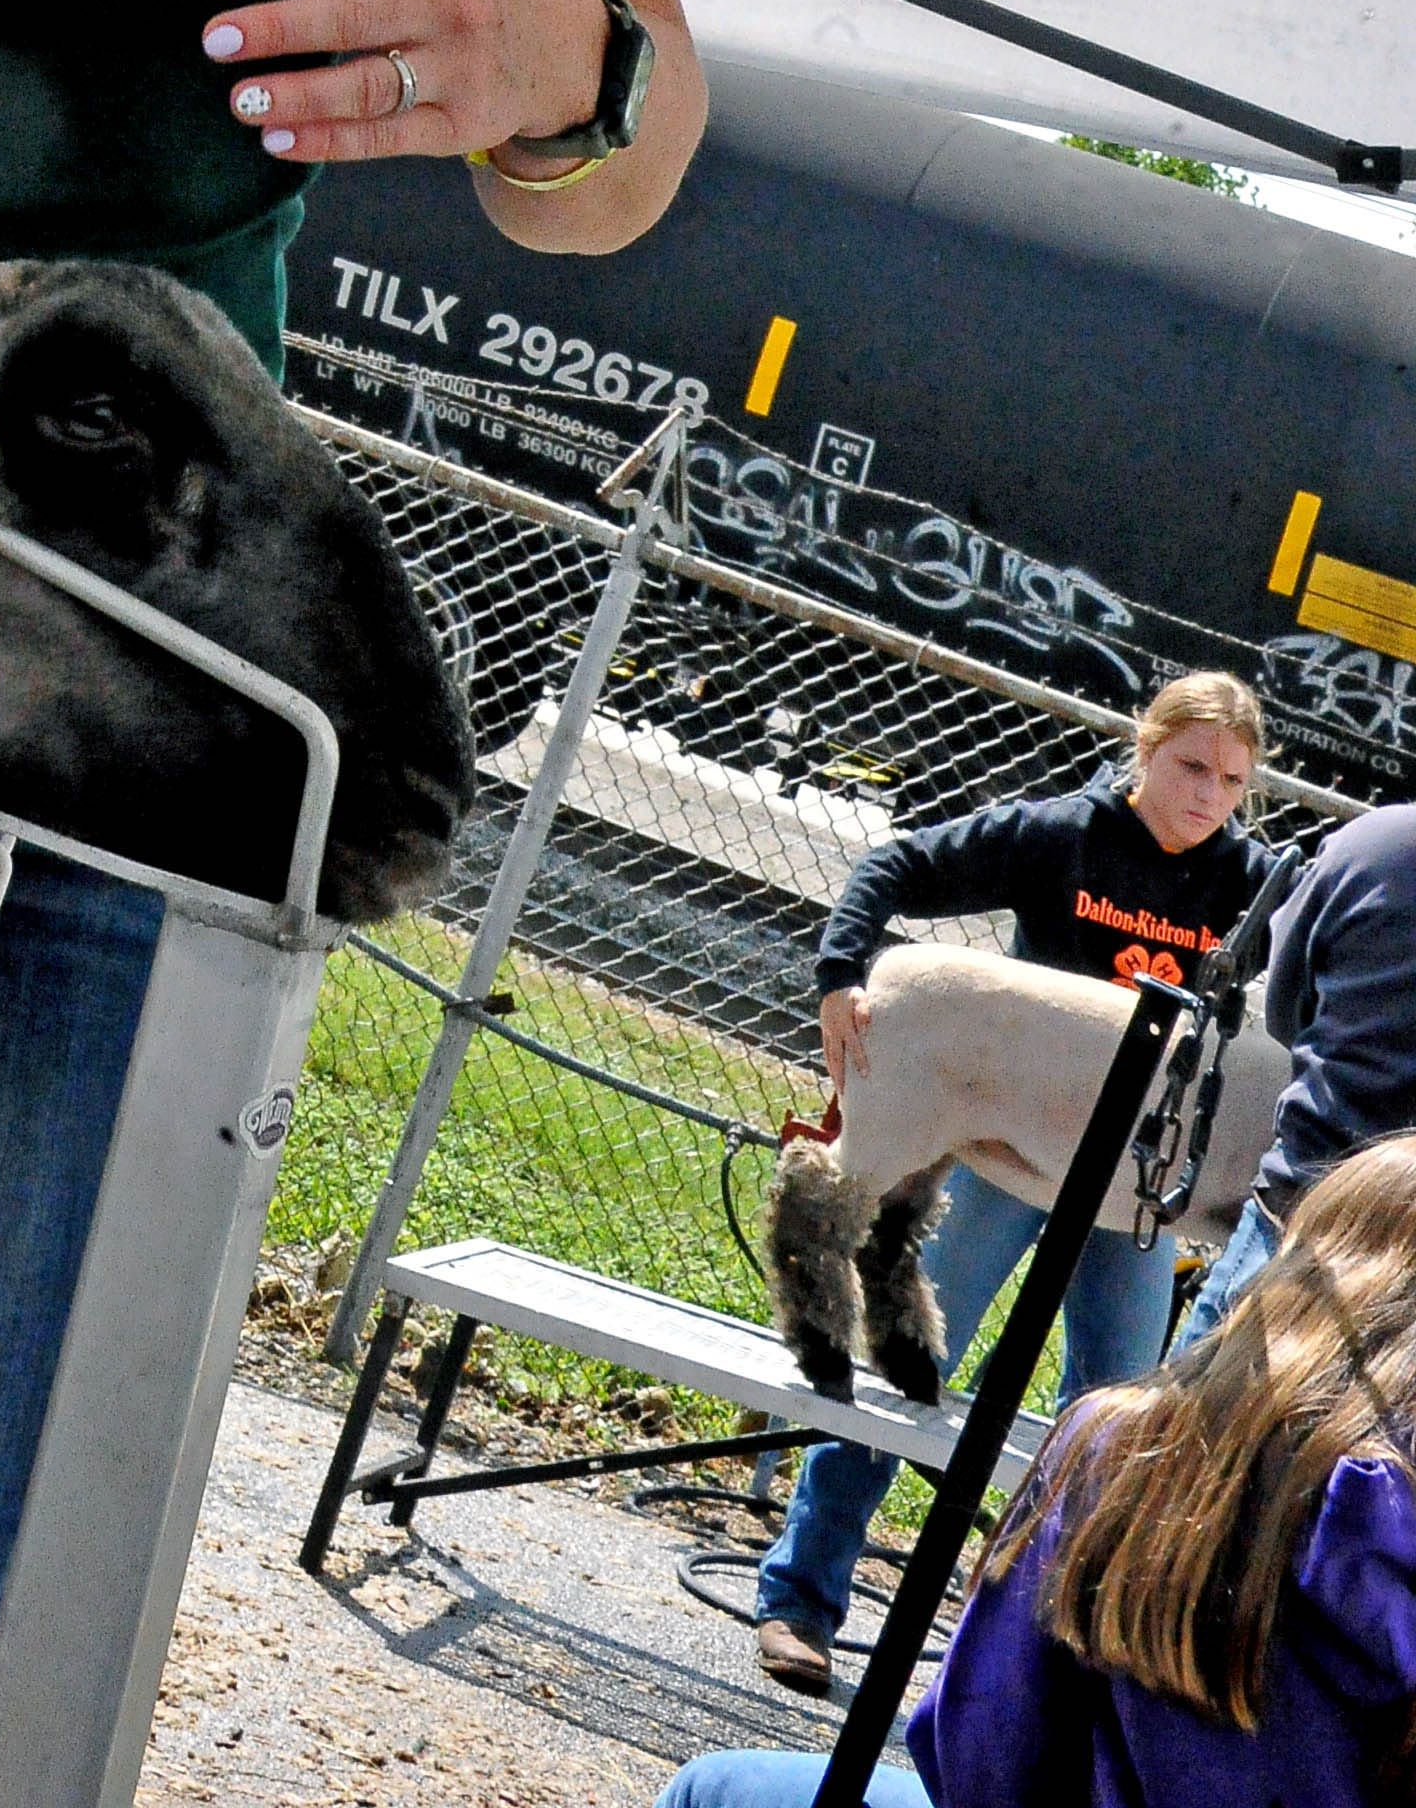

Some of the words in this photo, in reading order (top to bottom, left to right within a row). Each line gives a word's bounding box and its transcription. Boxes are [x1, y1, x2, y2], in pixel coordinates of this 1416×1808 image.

[333, 257, 460, 343] TILX
[479, 314, 709, 429] 292678
[317, 361, 337, 380] LT
[353, 372, 384, 397] WT
[479, 418, 507, 440] LB
[518, 432, 577, 467] 36300
[580, 453, 613, 478] KG
[485, 389, 512, 410] LB
[586, 425, 620, 450] KG
[828, 437, 861, 457] PLATE
[832, 457, 848, 476] C
[1075, 889, 1196, 950] Dalton-Kidron
